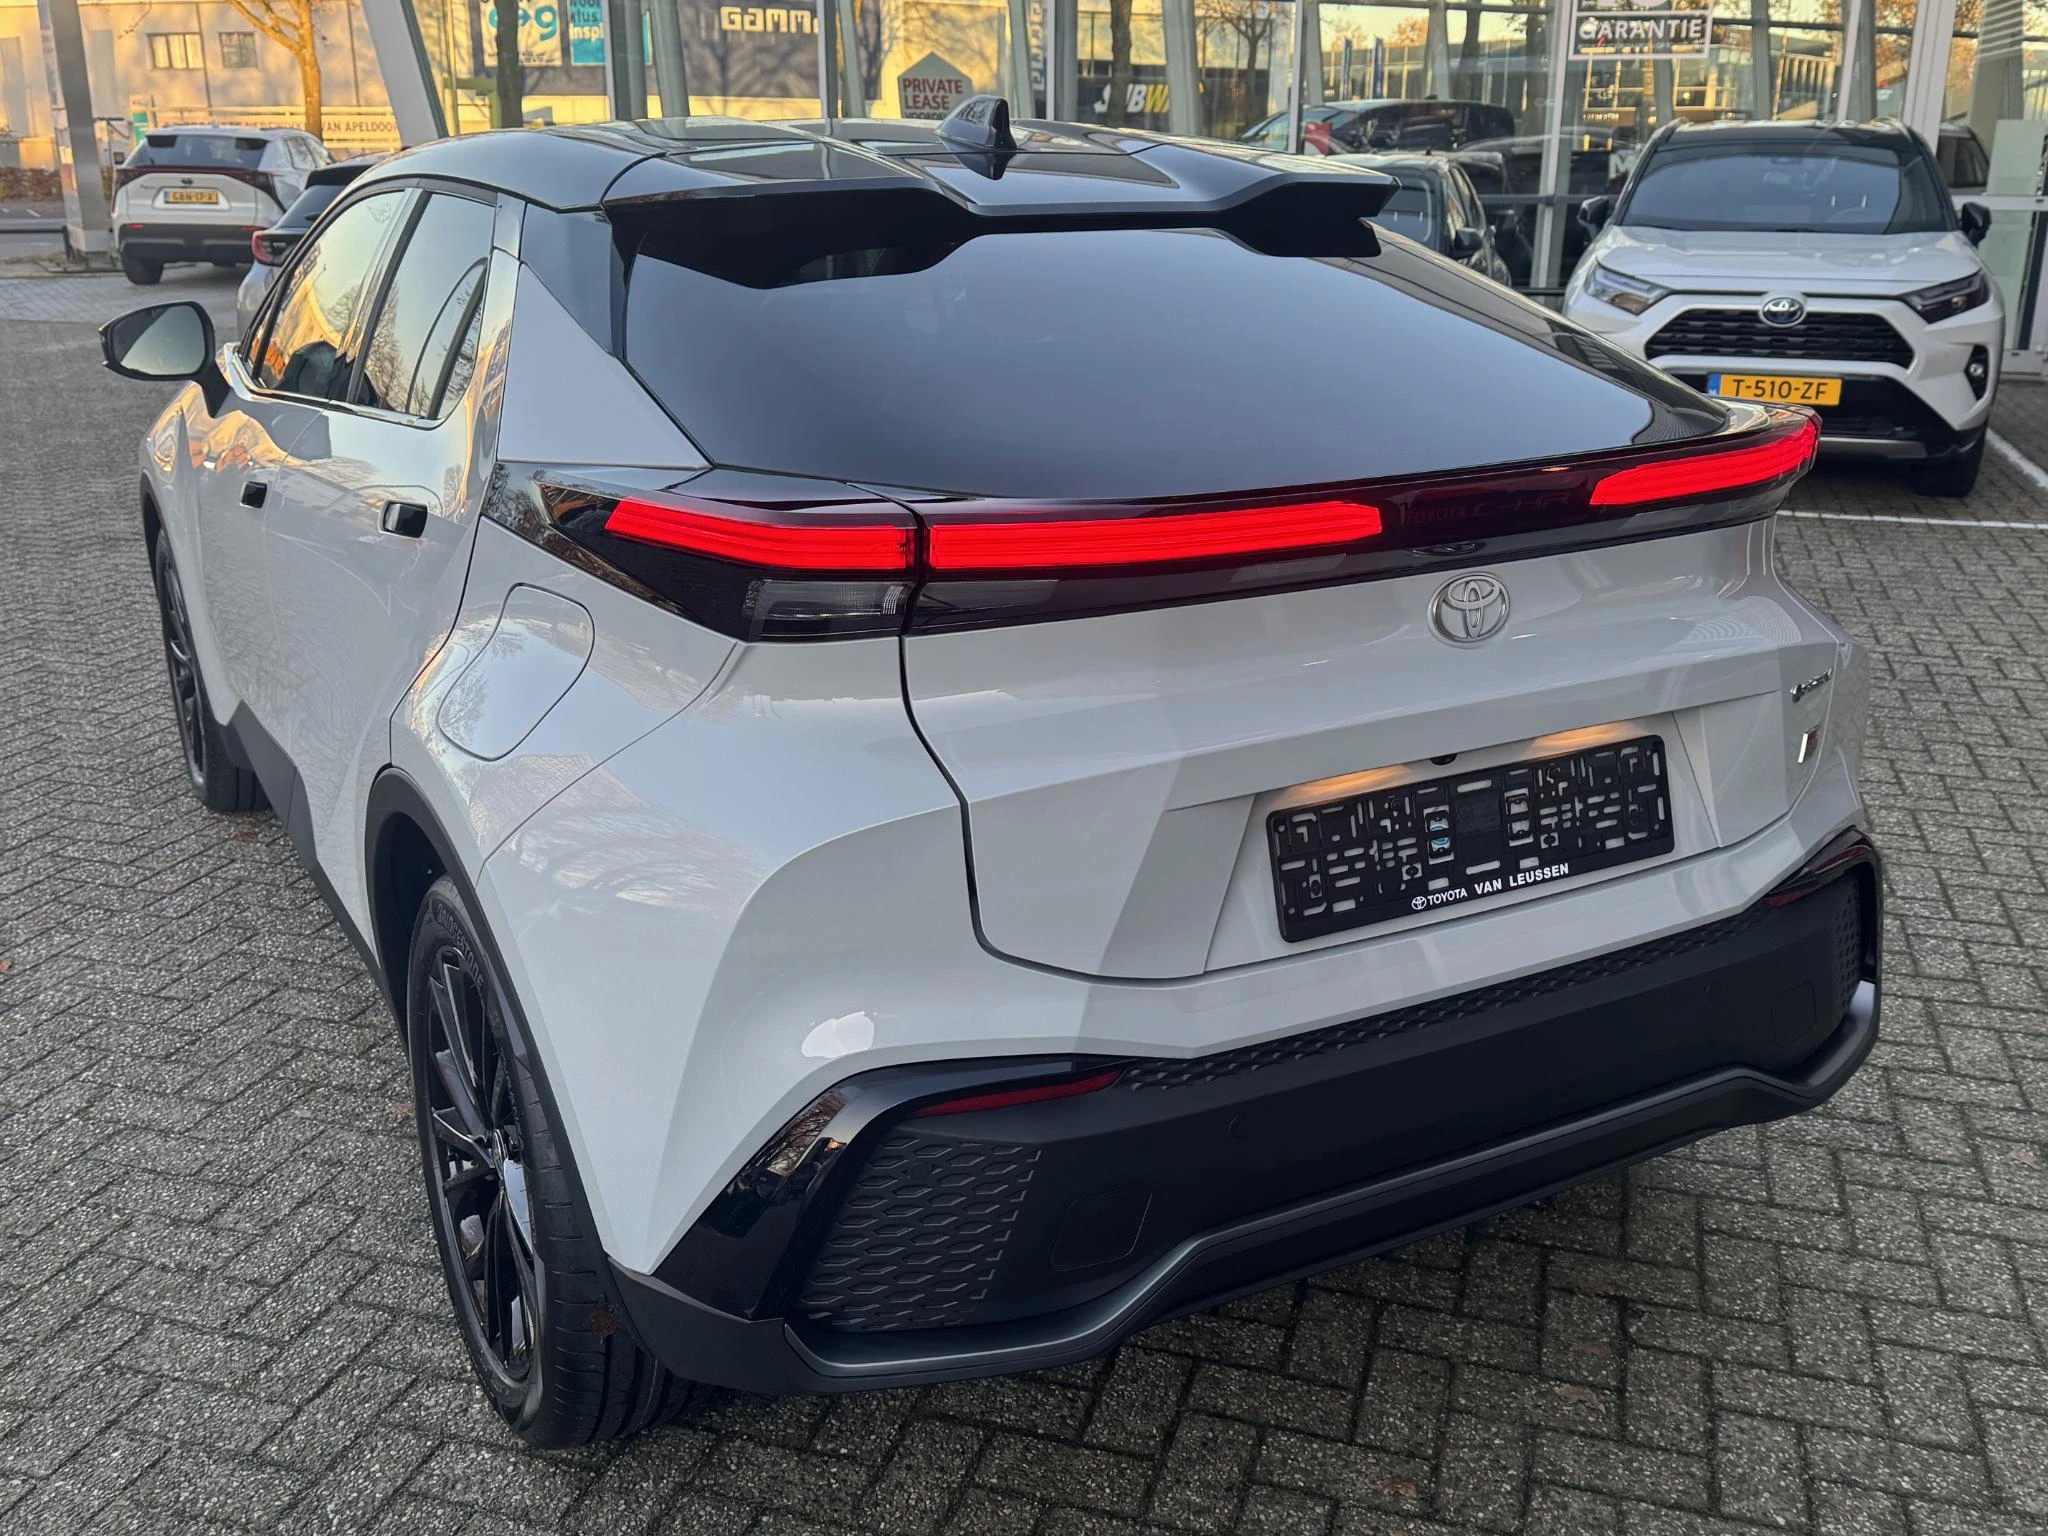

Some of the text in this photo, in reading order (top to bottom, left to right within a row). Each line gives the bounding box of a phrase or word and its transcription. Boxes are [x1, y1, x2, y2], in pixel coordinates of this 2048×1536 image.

[1579, 19, 1703, 39] GARANTIE
[903, 78, 963, 94] PRIVATE
[904, 95, 950, 110] LEASE
[345, 121, 396, 132] APELDOO
[1733, 378, 1828, 400] T-510-ZF
[1427, 862, 1569, 906] TOYOTA VAN LEUSSEN
